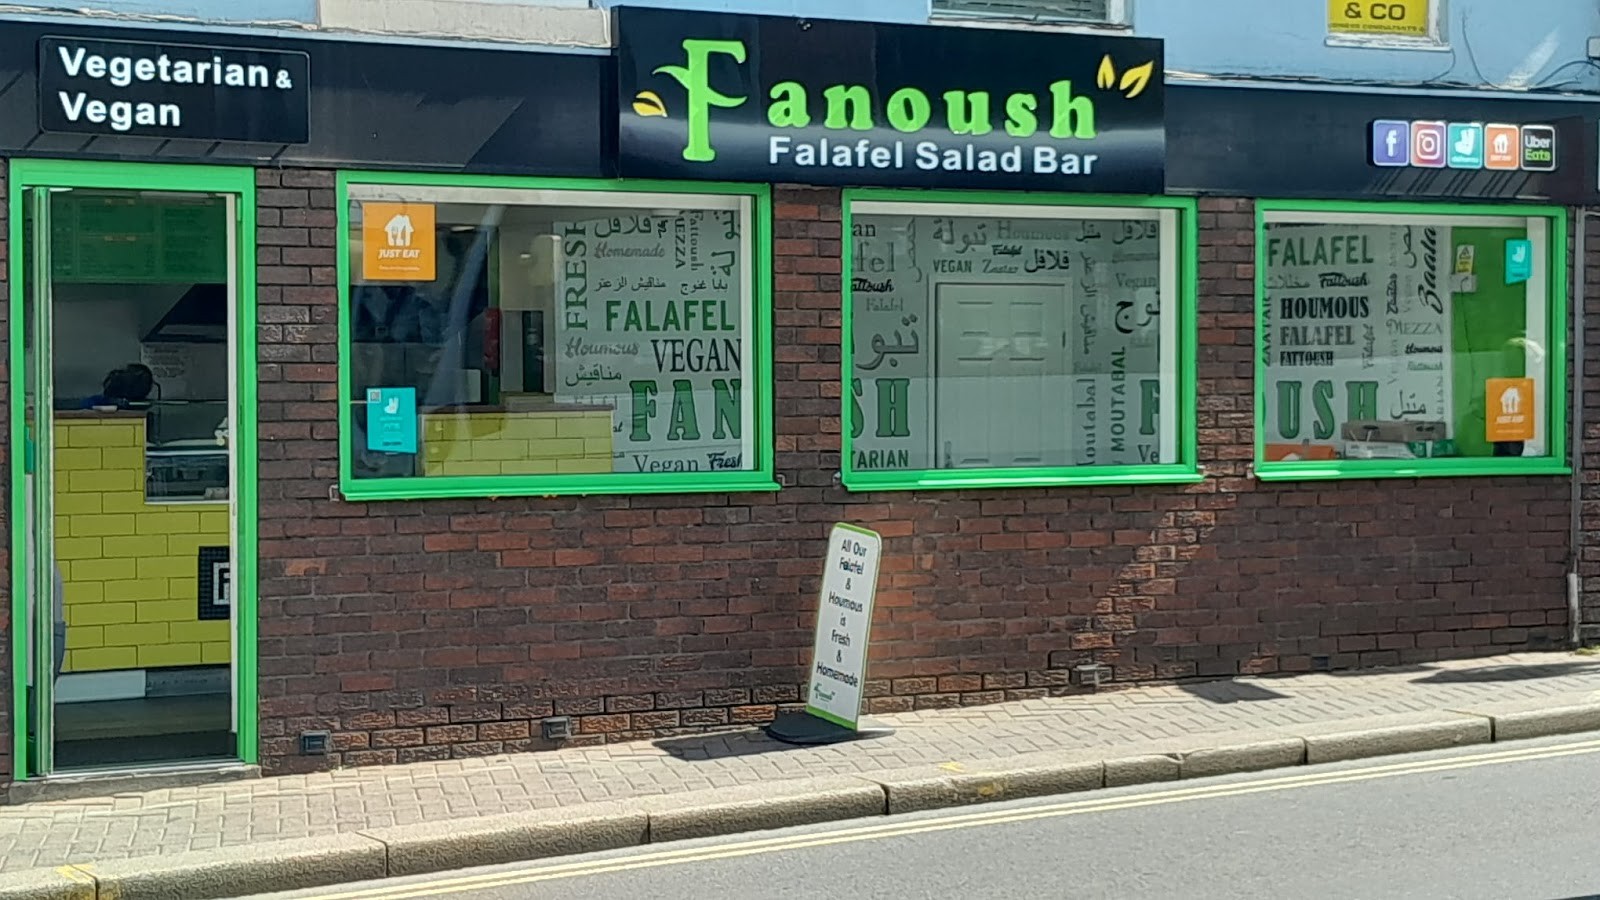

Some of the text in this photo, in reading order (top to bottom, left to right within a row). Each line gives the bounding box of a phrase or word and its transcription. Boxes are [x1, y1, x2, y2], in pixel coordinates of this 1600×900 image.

[1344, 2, 1405, 20] & CO
[58, 46, 293, 89] Vegetarian &
[58, 91, 181, 131] Vegan
[651, 38, 1097, 162] Fanoush
[1524, 135, 1551, 148] Uber
[768, 136, 1098, 175] Falafel Salad Bar
[378, 249, 420, 259] JUST EAT
[594, 242, 665, 259] Homemade
[853, 241, 896, 272] fel
[1268, 235, 1374, 266] FALAFEL
[933, 259, 972, 273] VEGAN
[606, 300, 735, 331] FALAFEL
[1280, 296, 1369, 319] HOUMOUS
[1280, 325, 1355, 346] FALAFEL
[565, 337, 640, 358] Houmous
[650, 338, 741, 373] VEGAN
[1280, 351, 1334, 366] FATTOUSH
[629, 378, 742, 441] FAN
[1110, 346, 1126, 452] MOUTABAL
[1276, 380, 1379, 440] USH
[633, 454, 699, 472] Vegan
[841, 539, 867, 558] All Our
[845, 578, 851, 591] &
[829, 591, 863, 613] Houmous
[831, 629, 850, 648] Fresh
[836, 649, 842, 663] &
[816, 661, 859, 688] Homemade
